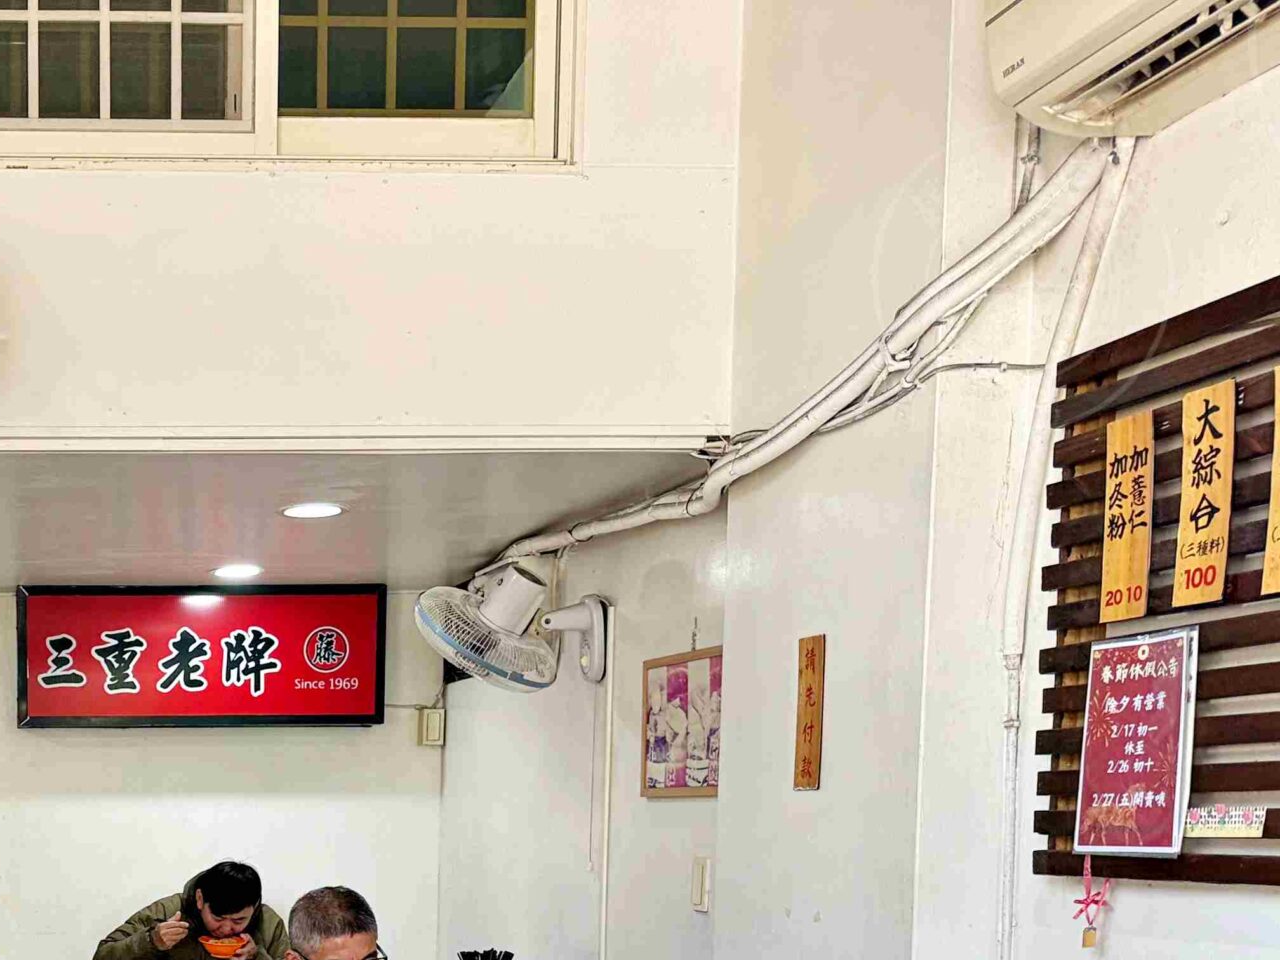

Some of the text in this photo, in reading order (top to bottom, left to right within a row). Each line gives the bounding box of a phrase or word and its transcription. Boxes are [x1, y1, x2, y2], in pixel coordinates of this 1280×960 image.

[1188, 398, 1224, 535] 大綜合
[1128, 444, 1150, 535] 加薏仁
[1184, 564, 1218, 591] 100
[36, 625, 282, 697] 三重老牌
[1100, 657, 1180, 685] 春節休假公告
[294, 677, 359, 690] Since 1969
[1110, 724, 1135, 739] 2/17
[1107, 759, 1130, 774] 2/26
